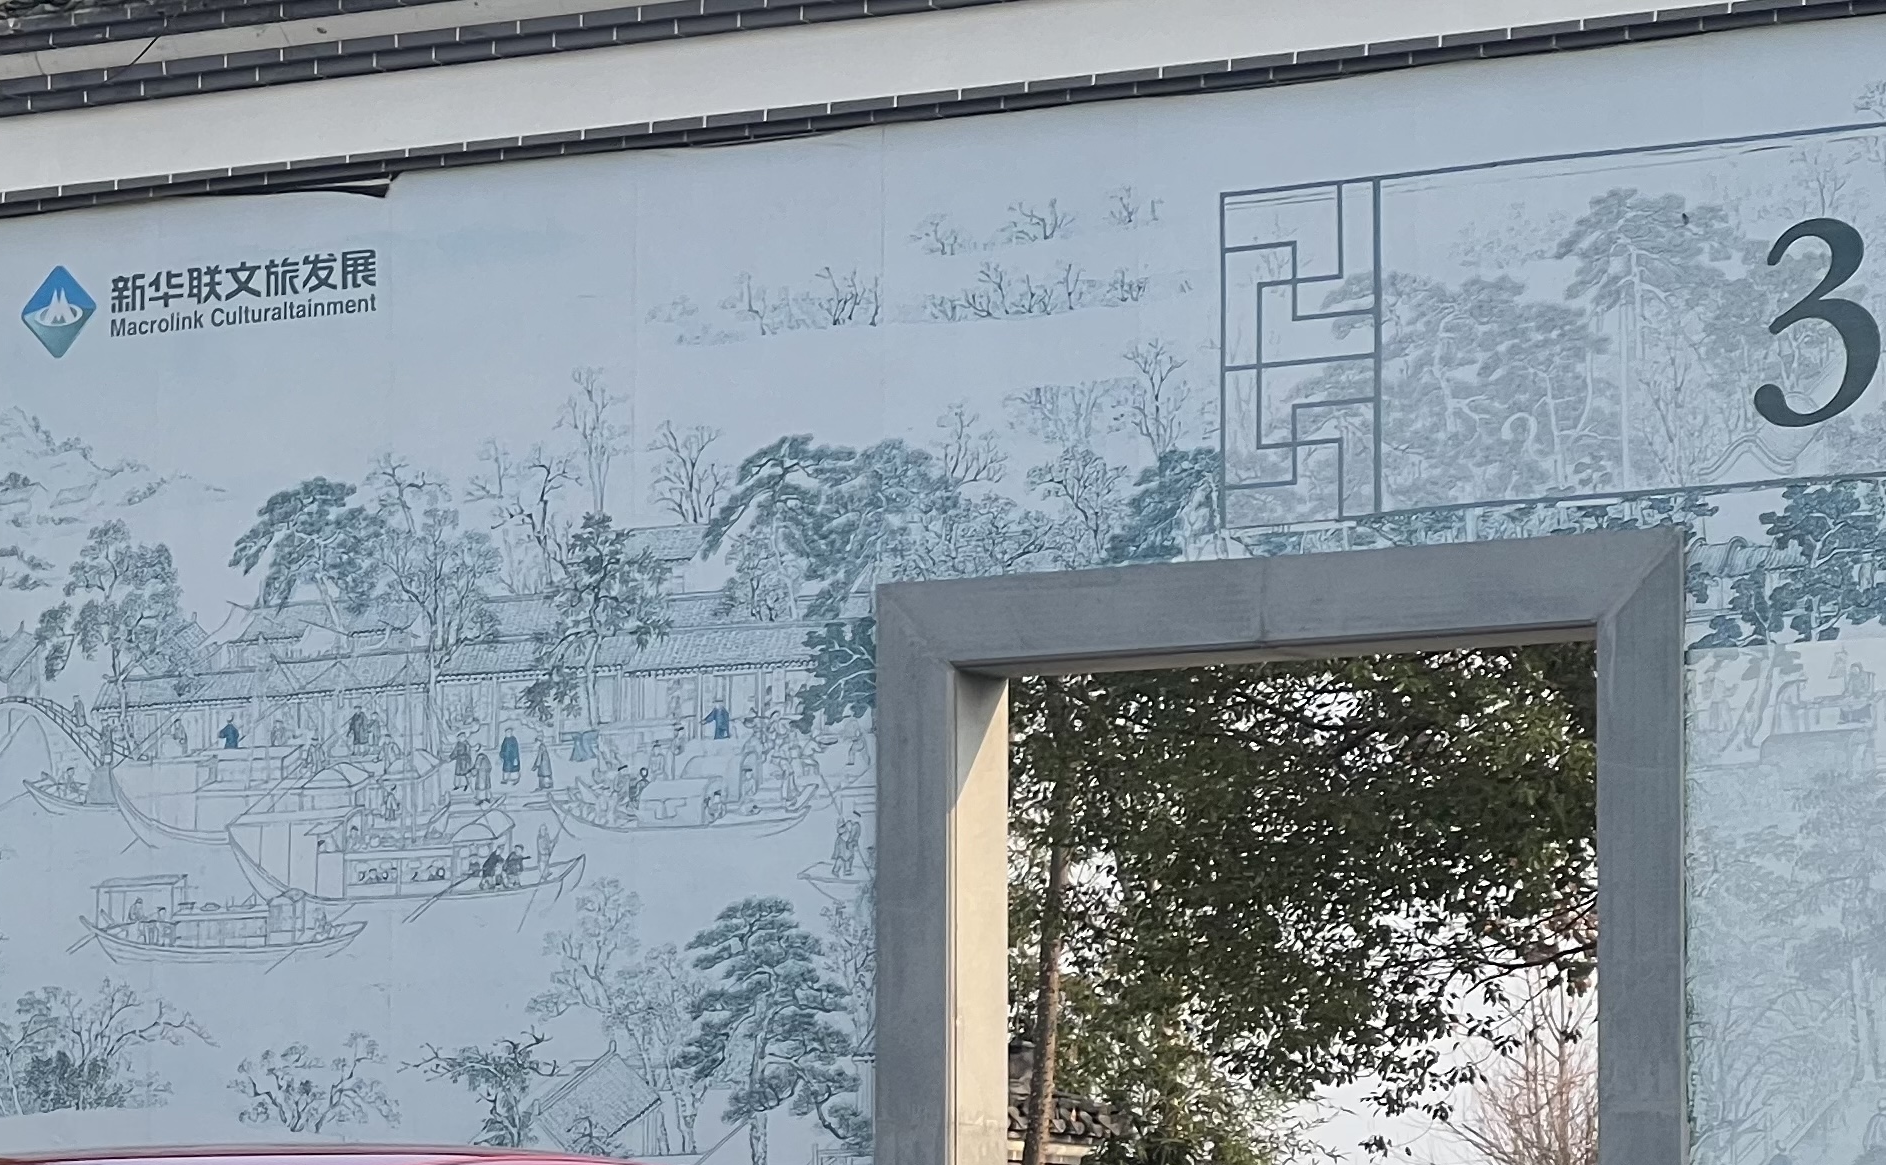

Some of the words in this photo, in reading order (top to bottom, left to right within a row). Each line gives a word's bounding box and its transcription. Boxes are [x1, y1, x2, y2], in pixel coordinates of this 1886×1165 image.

[110, 248, 377, 314] 新华联文旅发展
[110, 310, 204, 338] Macrolink
[211, 293, 377, 328] Culturaltainment
[1754, 217, 1881, 428] 3
